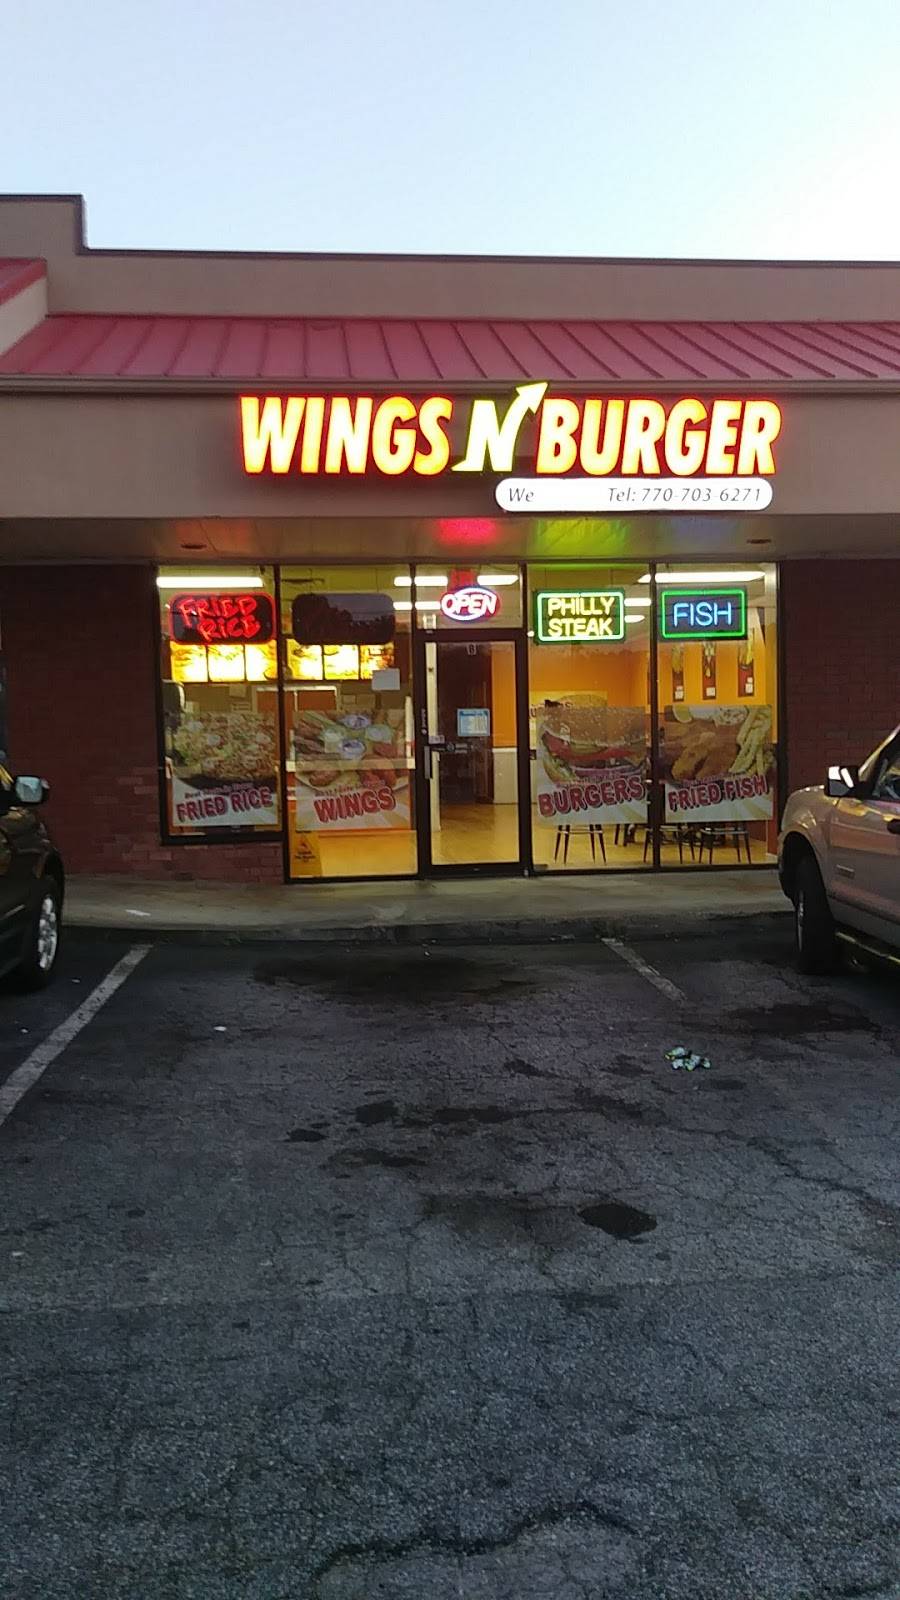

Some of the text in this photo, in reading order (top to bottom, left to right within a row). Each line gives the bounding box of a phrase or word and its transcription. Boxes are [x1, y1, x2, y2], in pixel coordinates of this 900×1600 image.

[240, 395, 453, 476] WINGS
[536, 397, 783, 477] BURGER
[508, 487, 534, 503] We
[607, 487, 636, 503] Tel:
[178, 595, 258, 628] FRIED
[441, 591, 499, 616] OPEN
[546, 596, 616, 617] PHILLY
[672, 601, 733, 627] FISH
[197, 615, 261, 642] RICE
[547, 617, 614, 637] STEAK
[175, 794, 229, 823] FRIED
[230, 786, 275, 813] RICE
[312, 785, 397, 824] WINGS
[537, 774, 647, 817] BURGERS
[667, 782, 723, 812] FRIED
[724, 773, 769, 800] FISH
